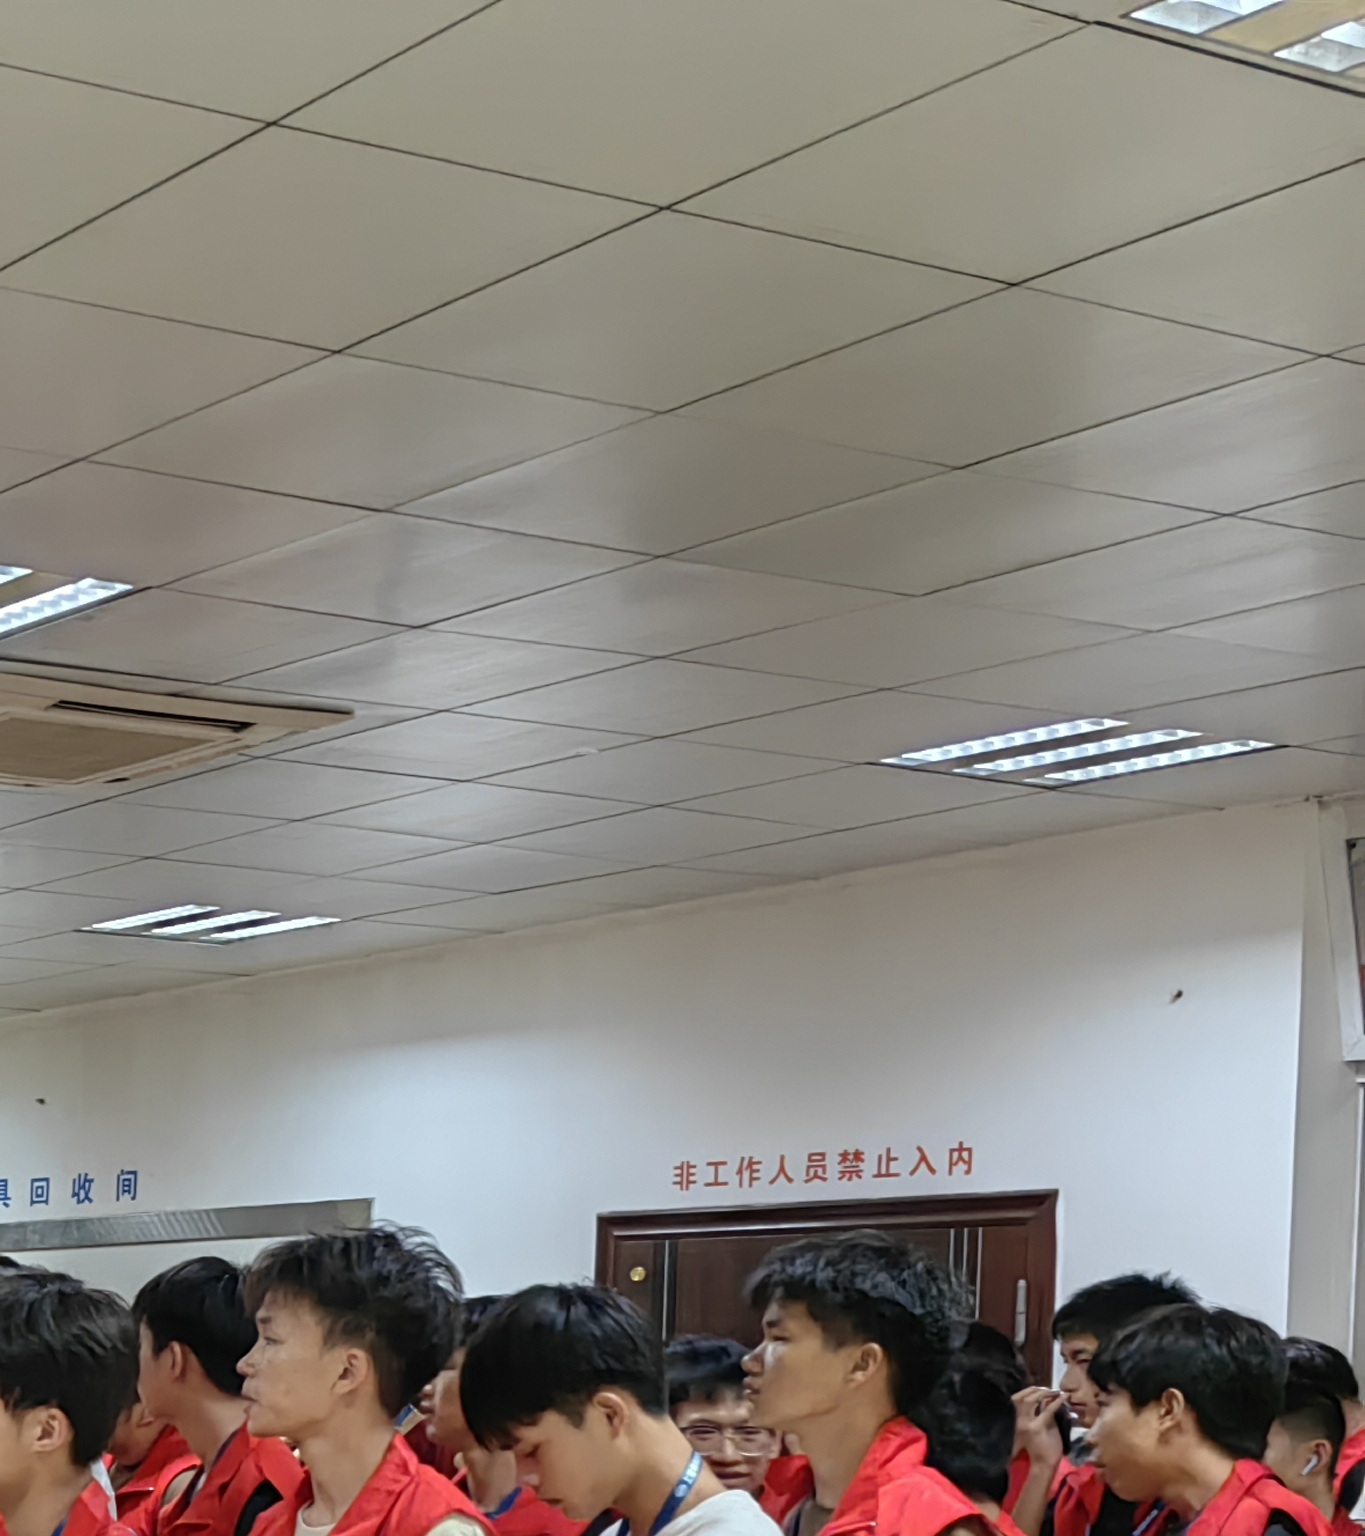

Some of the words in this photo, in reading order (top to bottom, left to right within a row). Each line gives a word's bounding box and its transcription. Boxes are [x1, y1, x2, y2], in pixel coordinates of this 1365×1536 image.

[672, 1141, 974, 1191] 非工作人员禁止入内
